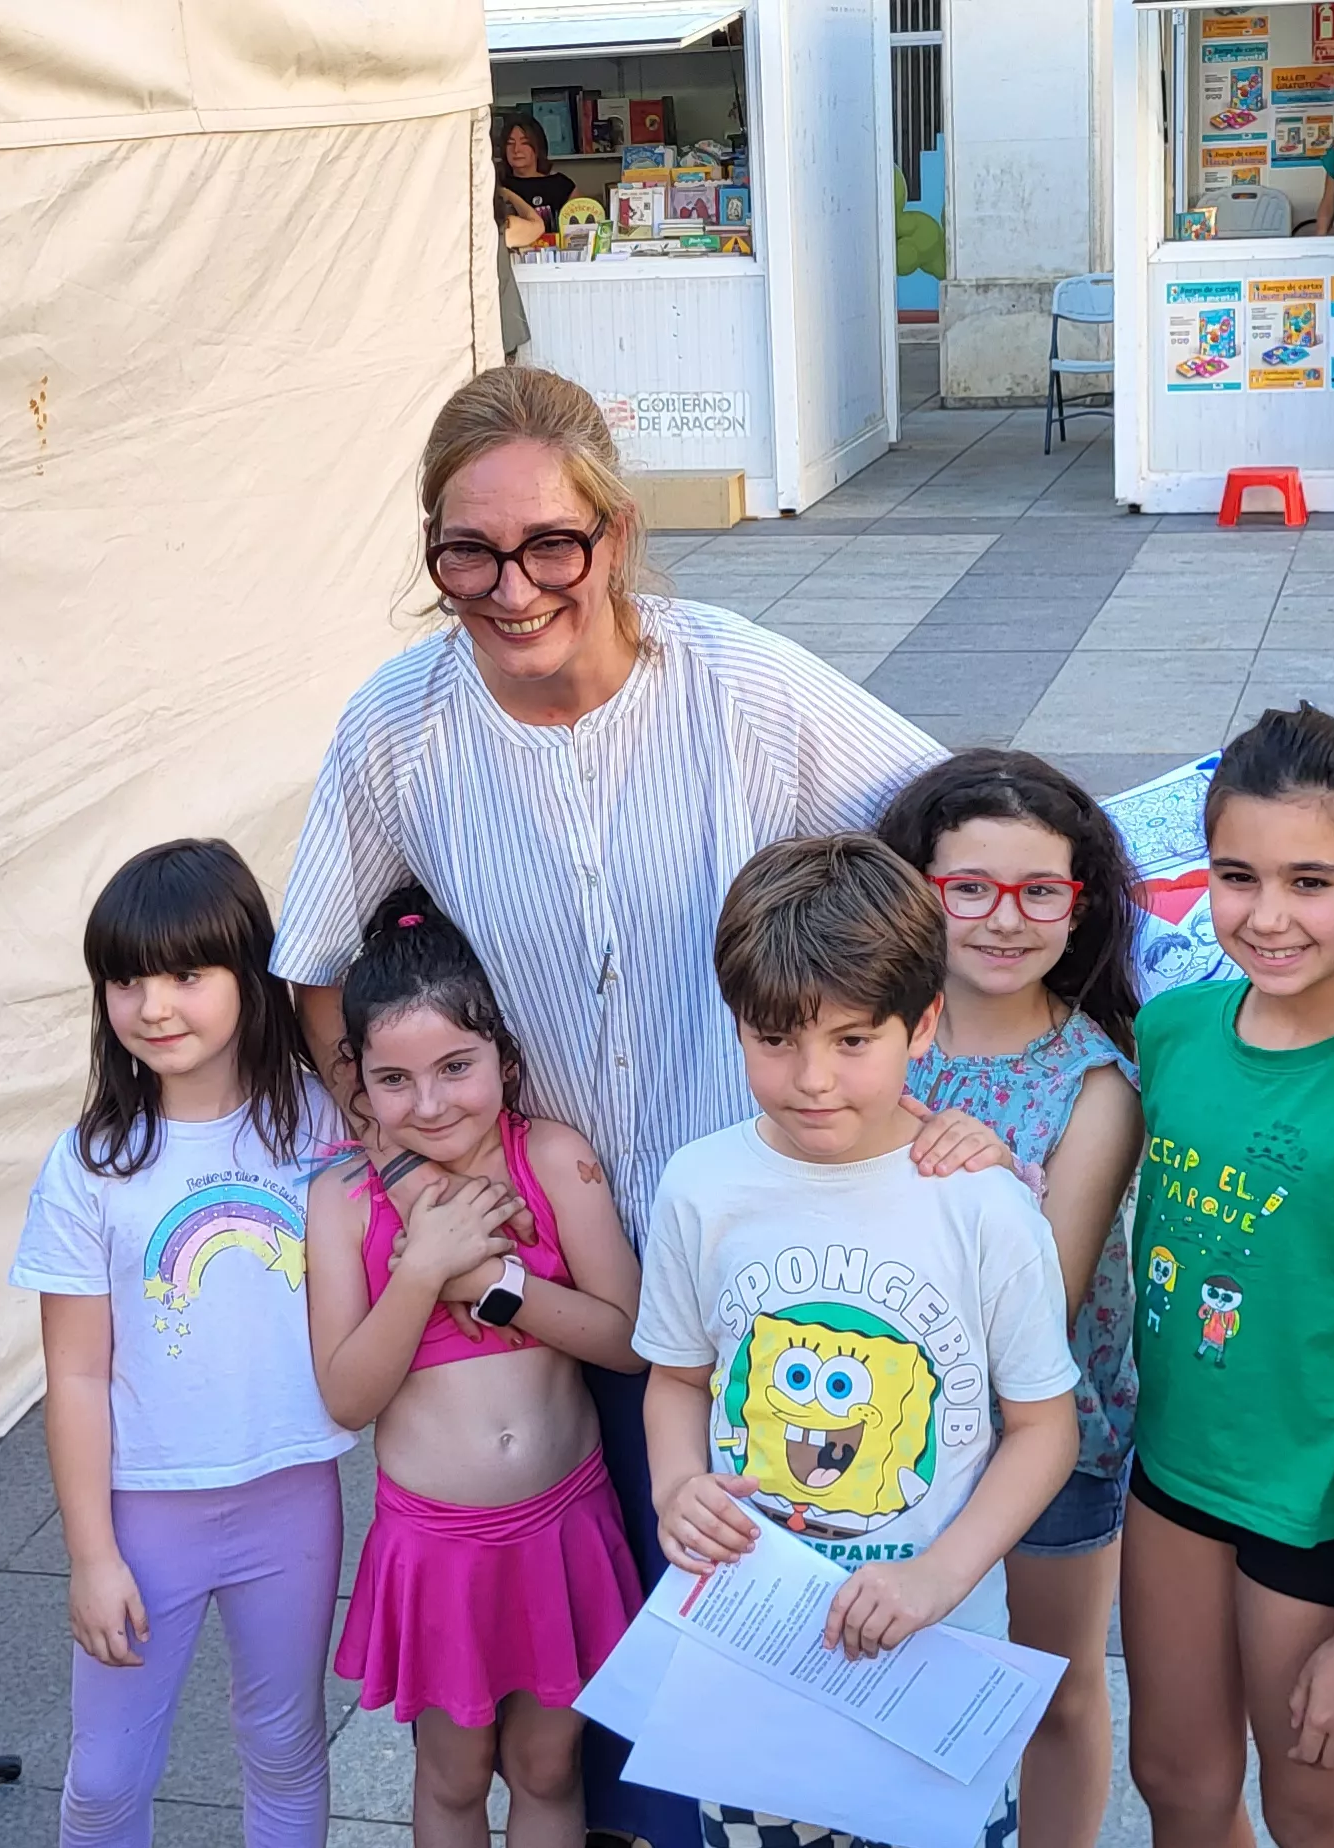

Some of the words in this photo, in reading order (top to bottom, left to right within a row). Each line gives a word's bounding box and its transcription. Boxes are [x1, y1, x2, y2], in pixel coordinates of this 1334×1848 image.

[637, 397, 732, 413] GOBIERNO
[638, 416, 661, 432] DE
[1218, 1164, 1252, 1200] EL
[718, 1244, 984, 1448] SPONGEBOB
